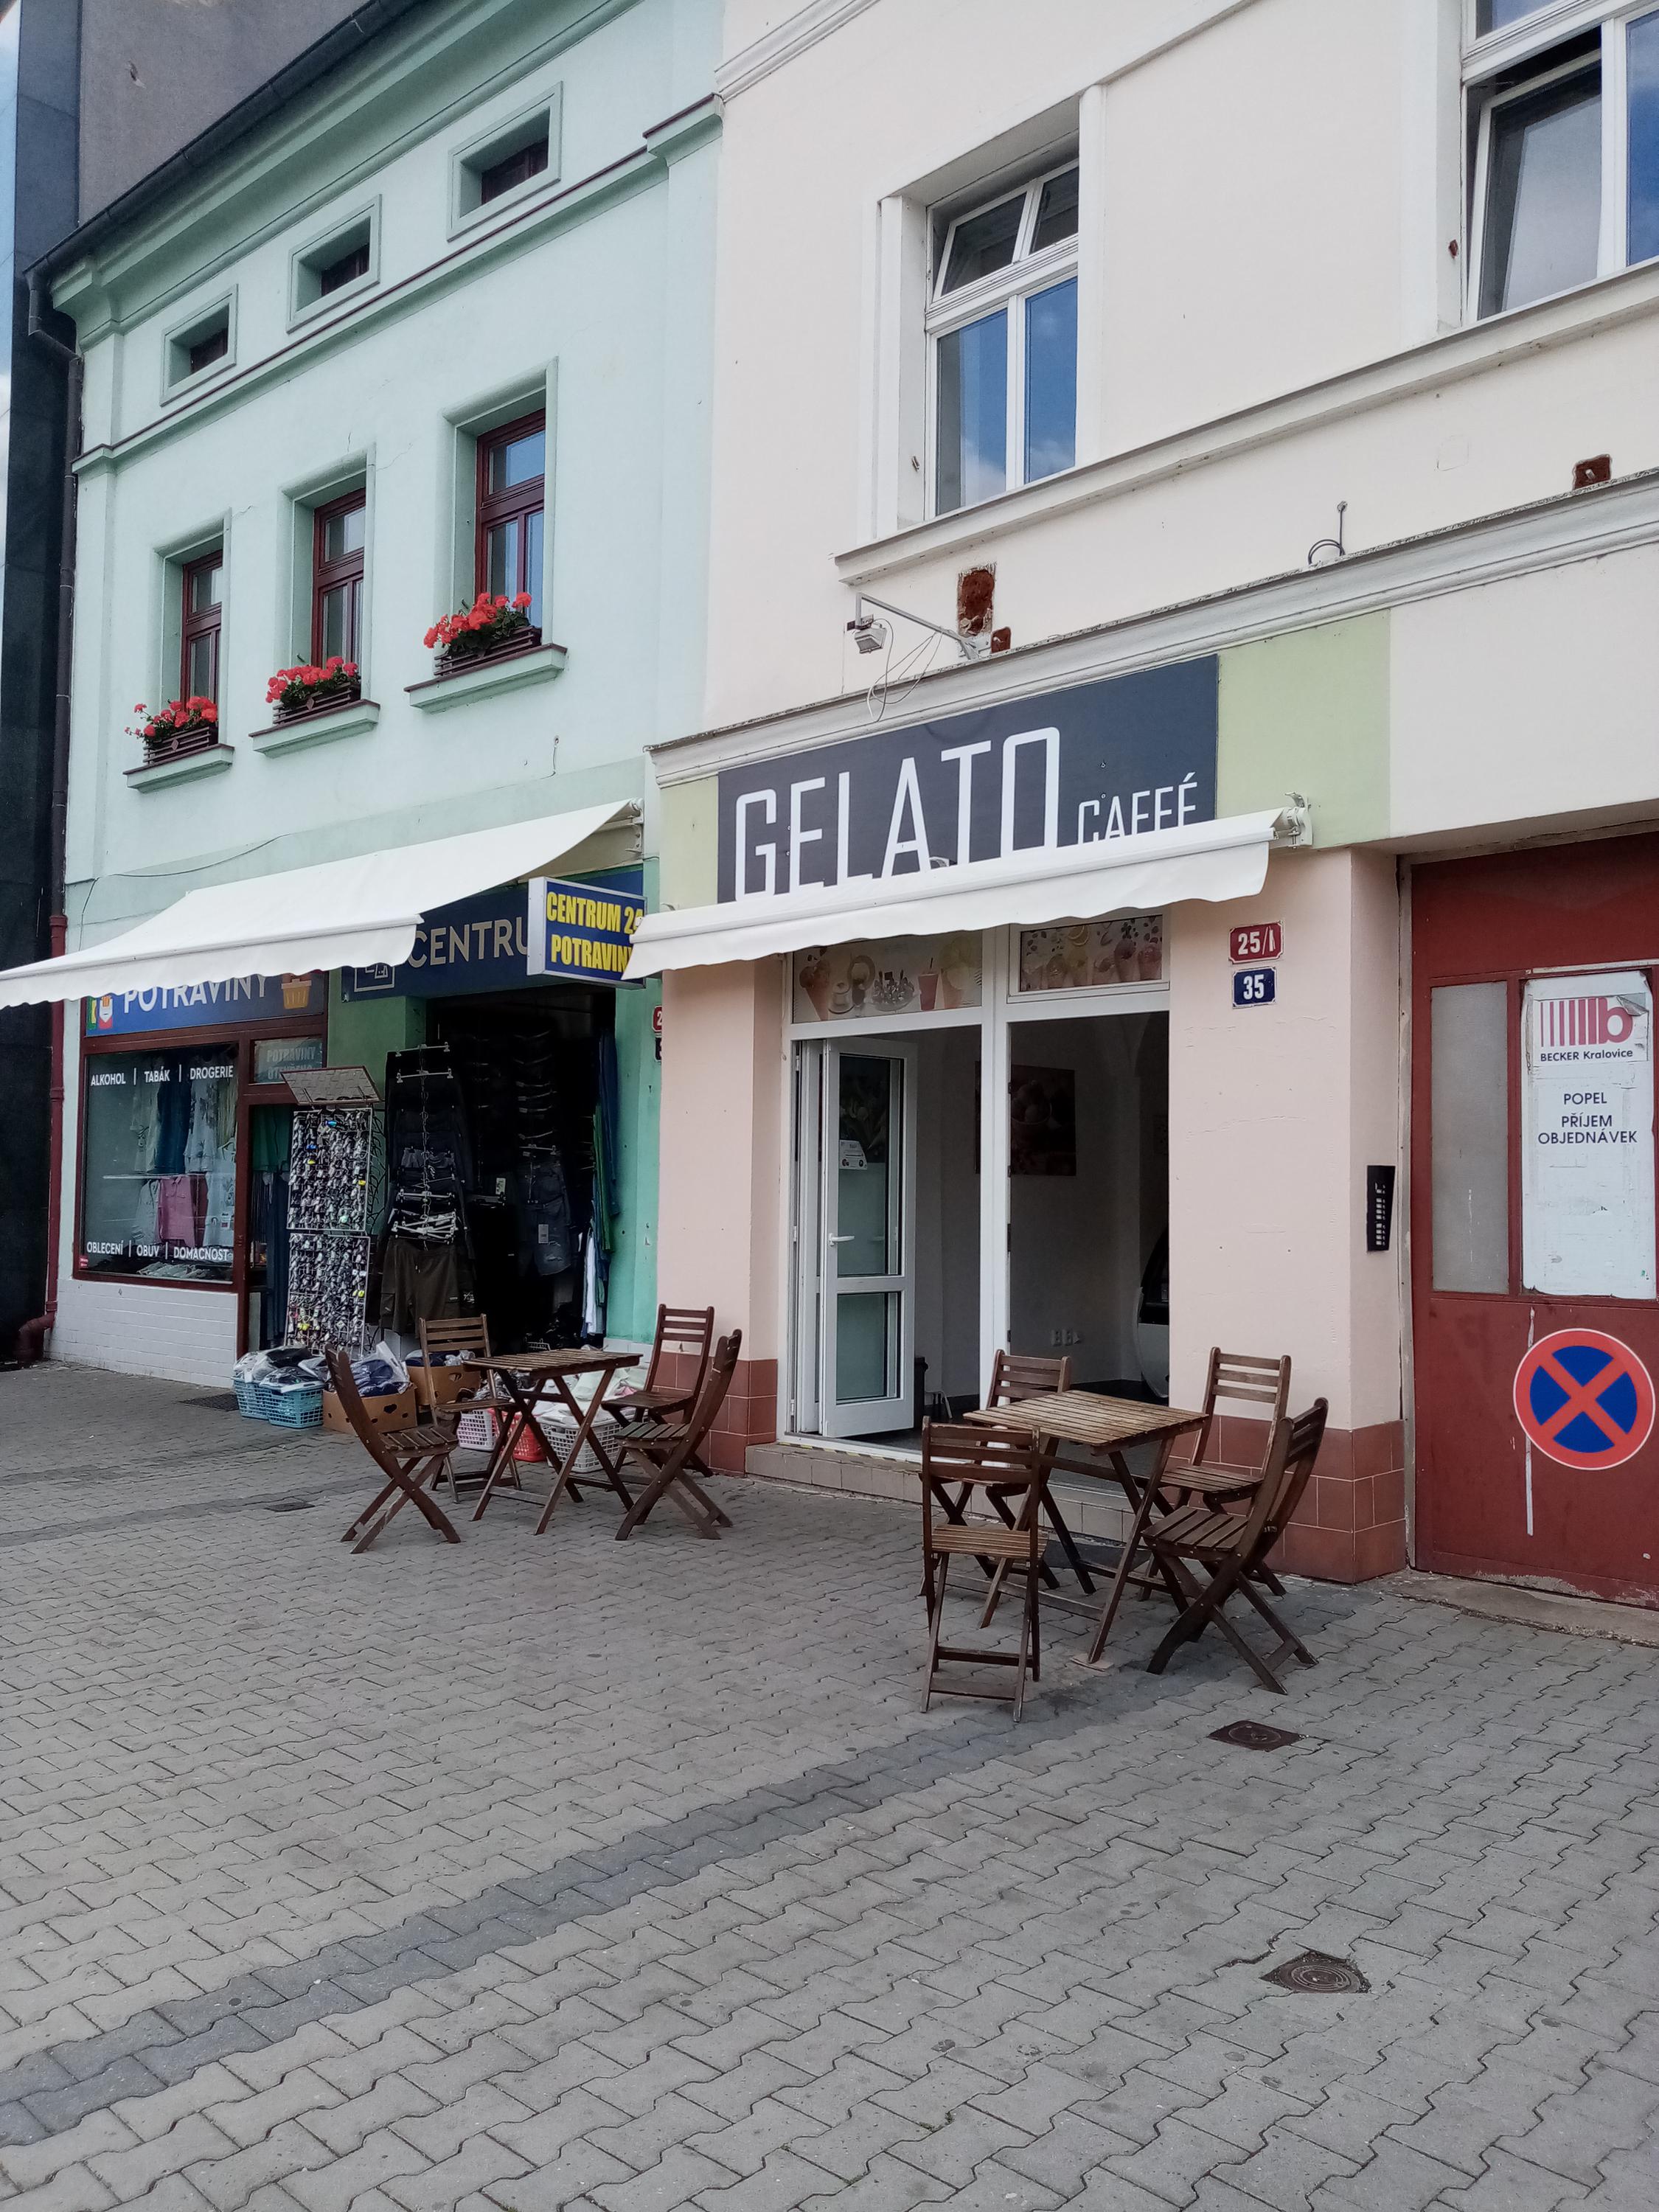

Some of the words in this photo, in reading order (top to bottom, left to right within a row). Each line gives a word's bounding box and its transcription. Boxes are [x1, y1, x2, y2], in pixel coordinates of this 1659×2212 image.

[735, 726, 1060, 902] GELATO
[1078, 771, 1198, 845] CAFFÉ
[546, 891, 621, 933] CENTRUM
[408, 917, 528, 968] CENTRU
[551, 934, 632, 973] POTRAVIN
[1243, 974, 1265, 1000] 35
[1540, 1051, 1579, 1062] BECKER
[1583, 1048, 1633, 1060] Kralovice
[90, 1073, 126, 1087] ALKOHOL
[144, 1066, 170, 1083] TABÁK
[189, 1065, 234, 1080] DROGERIE
[1563, 1092, 1607, 1105] POPEL
[1561, 1112, 1613, 1127] PŘÍJEM
[1538, 1127, 1638, 1144] OBJEDNÁVEK
[86, 1239, 124, 1255] OBLECENÍ
[136, 1245, 159, 1257] OBUV
